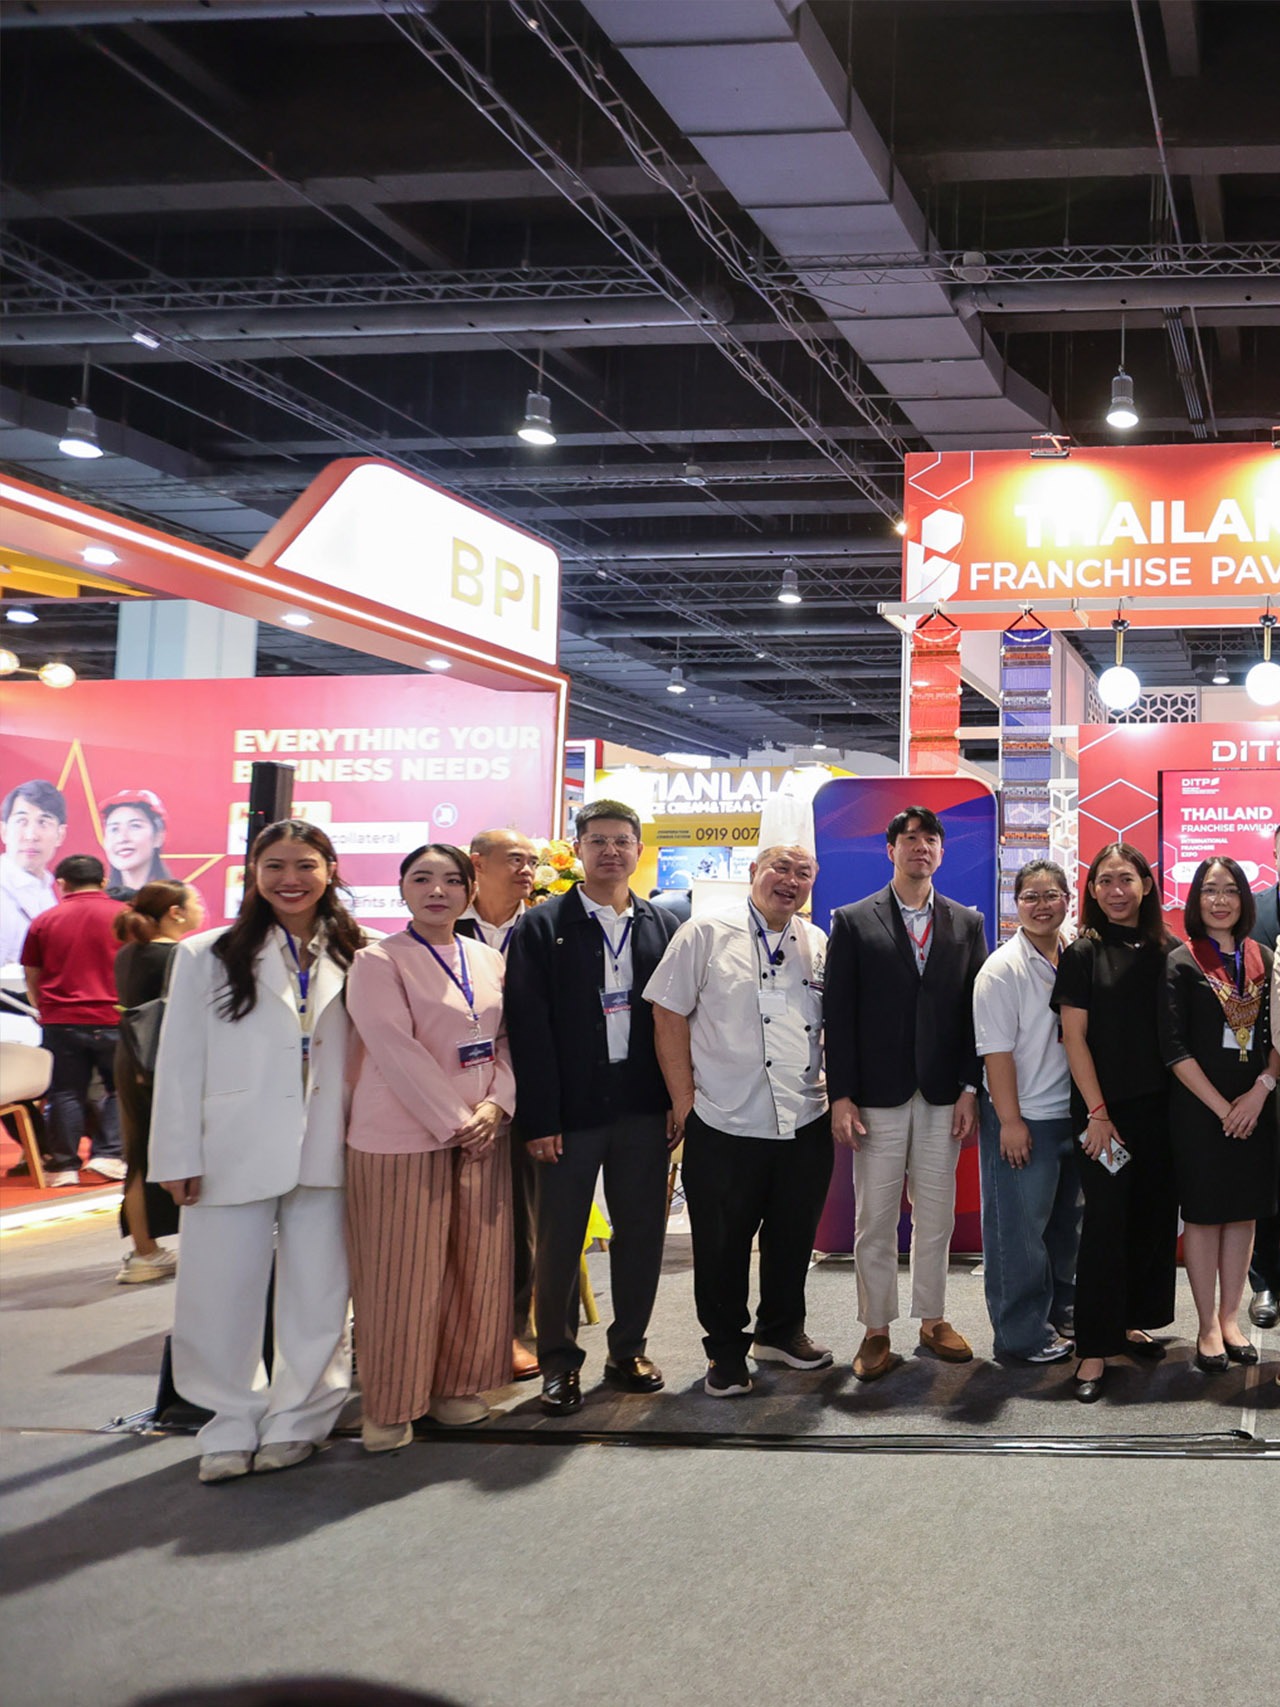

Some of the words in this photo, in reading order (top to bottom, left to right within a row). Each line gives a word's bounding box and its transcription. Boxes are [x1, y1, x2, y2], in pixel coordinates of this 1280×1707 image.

[450, 536, 540, 632] BPI
[970, 556, 1192, 591] FRANCHISE
[233, 727, 441, 753] EVERYTHING
[447, 725, 541, 751] YOUR
[232, 757, 393, 783] BINESS
[400, 756, 511, 782] NEEDS
[1180, 807, 1273, 821] THAILAND
[695, 827, 728, 841] 0919
[732, 827, 761, 841] 007
[1181, 824, 1235, 833] FRANCHISE
